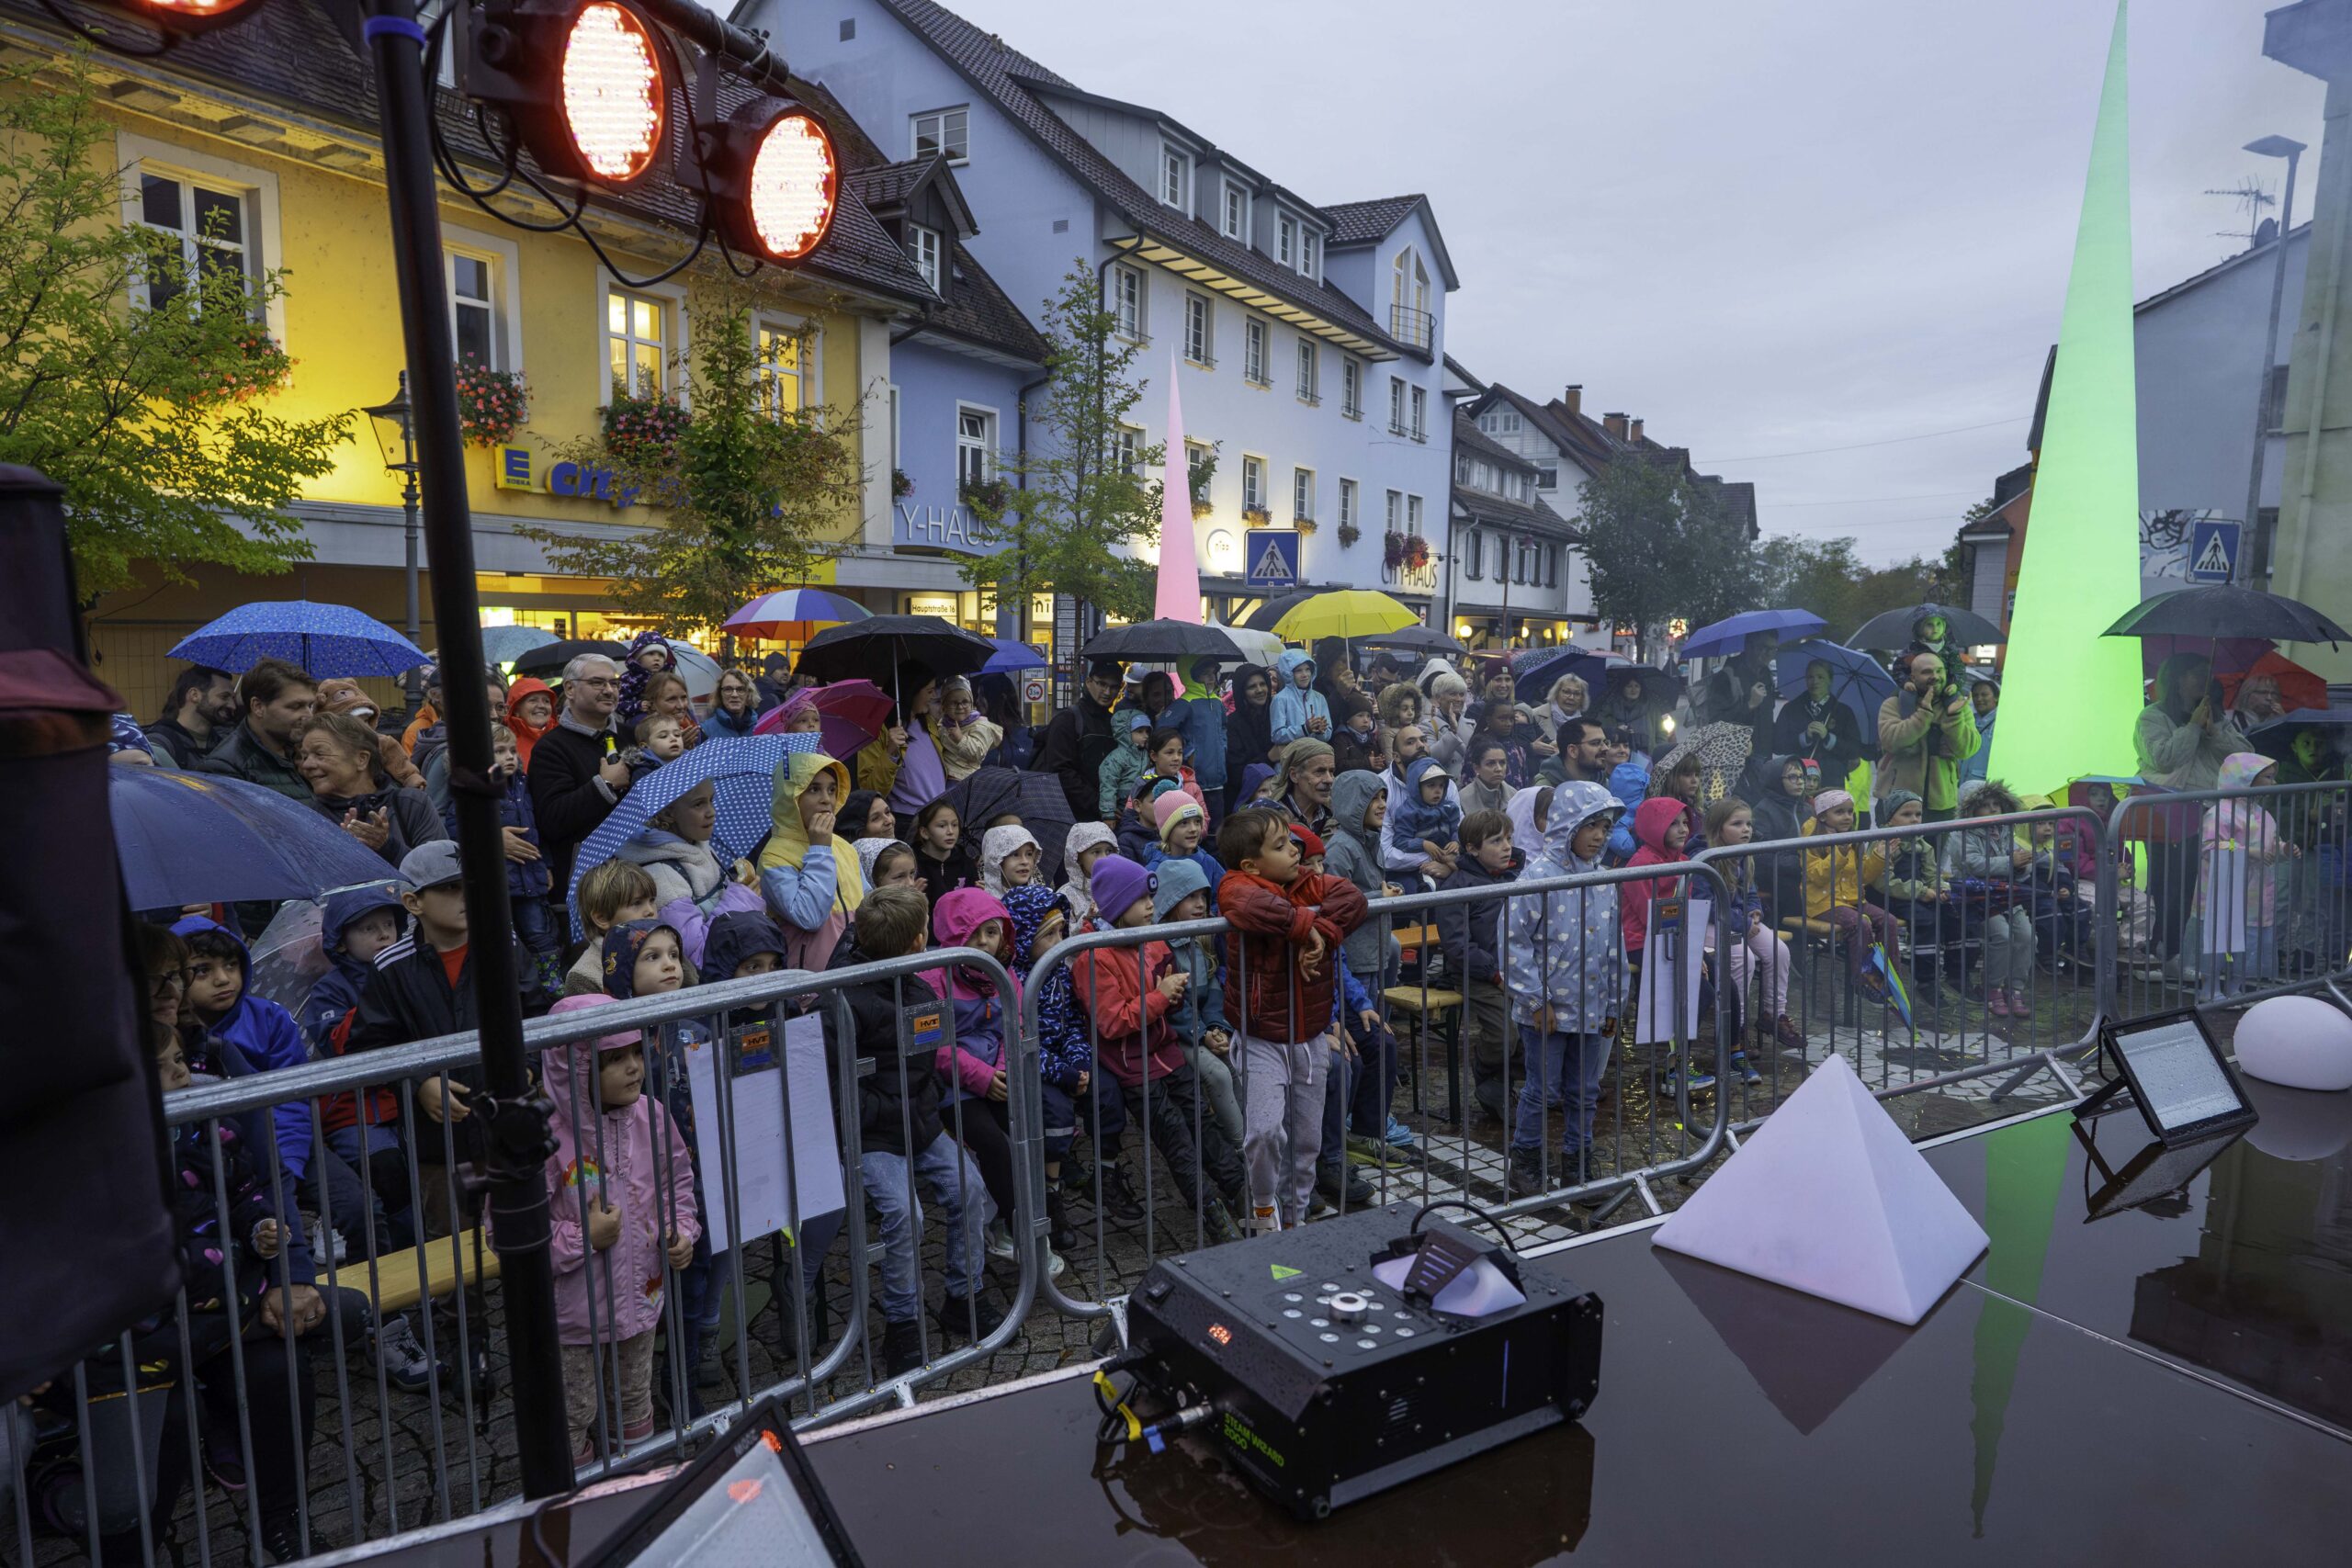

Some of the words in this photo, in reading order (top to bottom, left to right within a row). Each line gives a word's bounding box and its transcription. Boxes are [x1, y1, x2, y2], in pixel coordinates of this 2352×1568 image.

[911, 604, 948, 614] Hauptstraße
[1224, 1425, 1248, 1450] 2000
[1225, 1413, 1250, 1440] STEAM
